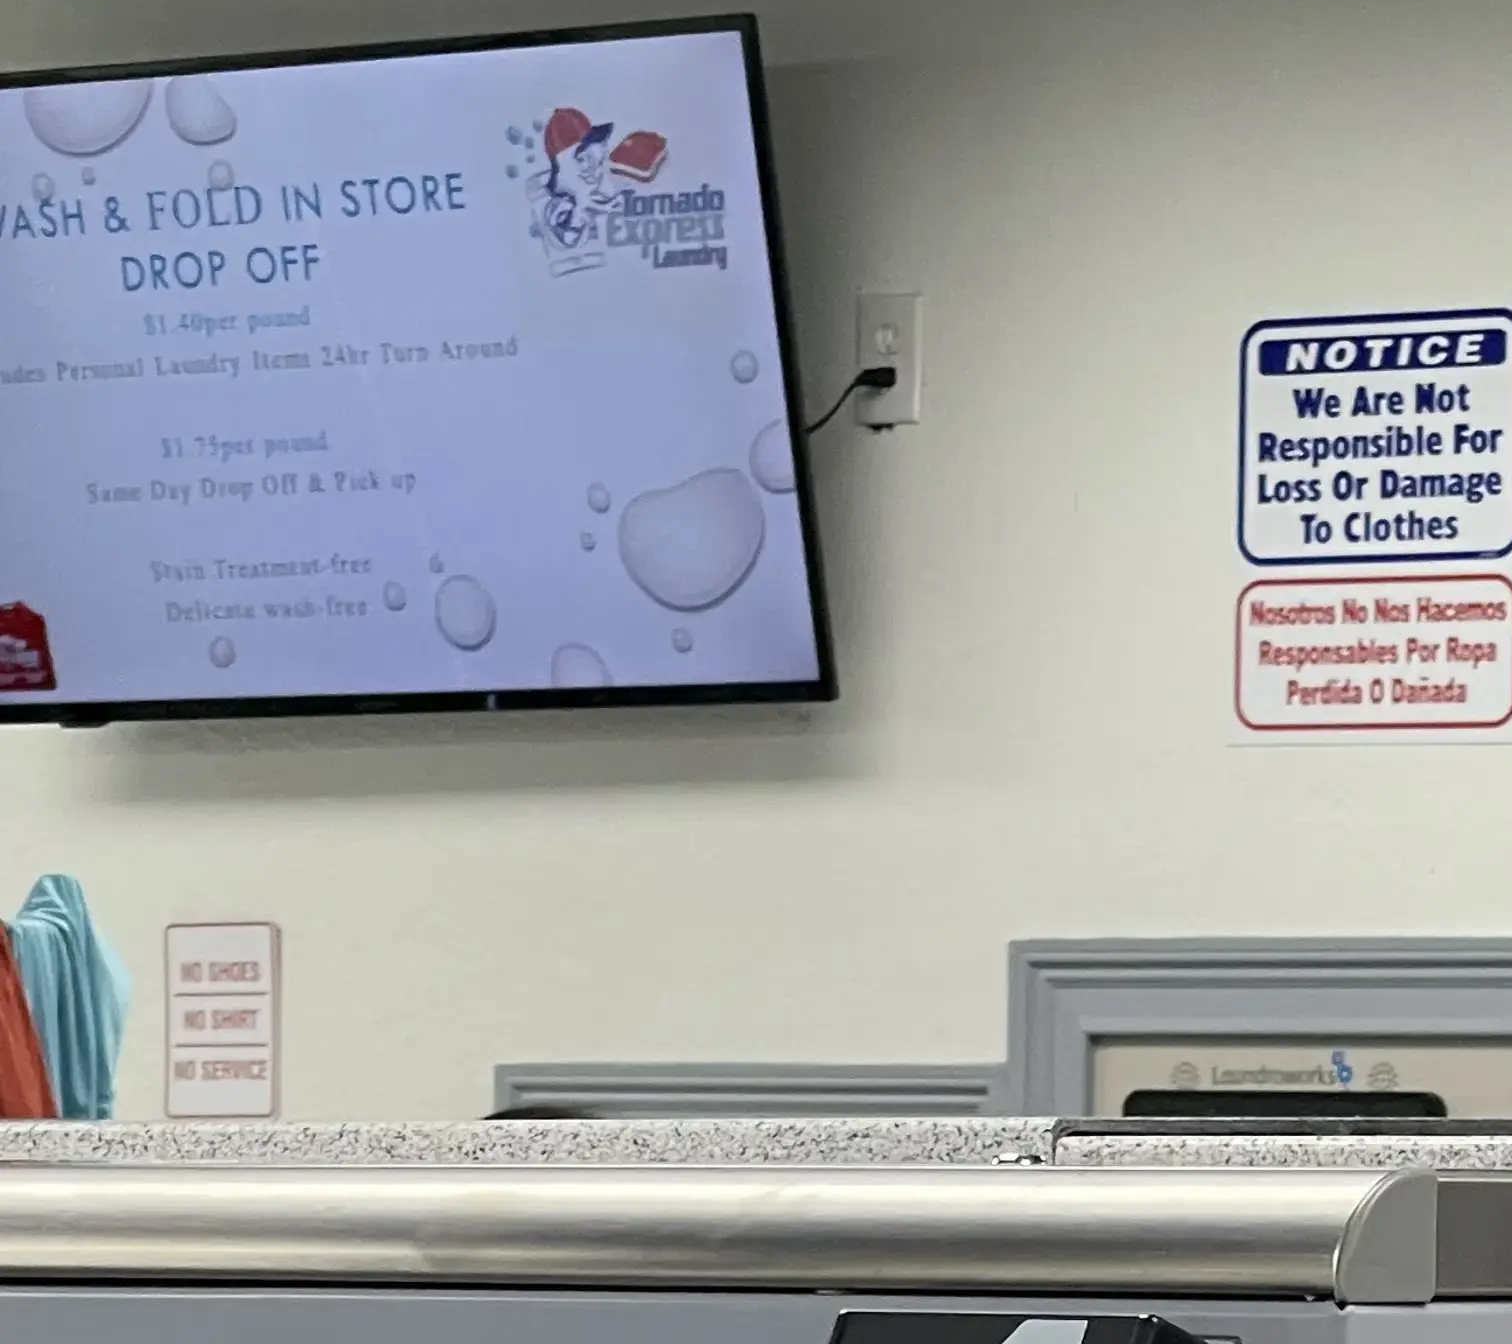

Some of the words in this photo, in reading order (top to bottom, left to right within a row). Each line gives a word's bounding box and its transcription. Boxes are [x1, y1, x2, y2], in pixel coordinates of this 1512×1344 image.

[0, 197, 86, 239] ASH
[104, 196, 130, 234] &
[146, 185, 262, 232] FOLD
[280, 181, 323, 225] IN
[340, 171, 467, 219] STORE
[621, 182, 726, 218] Tornado
[606, 212, 726, 260] Express
[120, 250, 226, 292] DROP
[247, 243, 320, 285] OFF
[653, 244, 728, 271] Laundry
[247, 304, 311, 335] pound
[57, 357, 144, 382] Personal
[154, 352, 240, 378] Laundry
[380, 341, 430, 365] Turn
[440, 334, 519, 361] Around
[1285, 331, 1486, 374] NOTICE
[1292, 387, 1341, 420] We
[1351, 385, 1404, 417] Are
[1415, 381, 1471, 414] Not
[1257, 425, 1443, 469] Responsible
[1453, 422, 1503, 455] For
[86, 482, 142, 505] Same
[150, 479, 192, 506] Day
[201, 476, 254, 502] Drop
[261, 472, 298, 497] Off
[334, 467, 380, 493] Pick
[390, 471, 417, 496] up
[1256, 473, 1322, 506] Loss
[1332, 469, 1369, 502] Or
[1379, 467, 1503, 504] Damage
[1299, 514, 1333, 545] To
[1343, 509, 1460, 543] Clothes
[151, 559, 205, 583] Stain
[1249, 598, 1336, 628] Nosotros
[1341, 598, 1368, 625] No
[1374, 597, 1411, 625] Nos
[1416, 595, 1509, 624] Hacemos
[1258, 637, 1399, 673] Responsables
[1406, 636, 1441, 664] Por
[1446, 635, 1499, 669] Ropa
[1286, 678, 1363, 706] Perdida
[1369, 677, 1385, 704] O
[1391, 675, 1469, 705] Dañada
[180, 961, 203, 983] NO
[208, 960, 260, 982] SHOES
[183, 1009, 206, 1030] NO
[211, 1008, 260, 1030] SHIRT
[174, 1059, 196, 1081] NO
[201, 1059, 268, 1081] SERVICE
